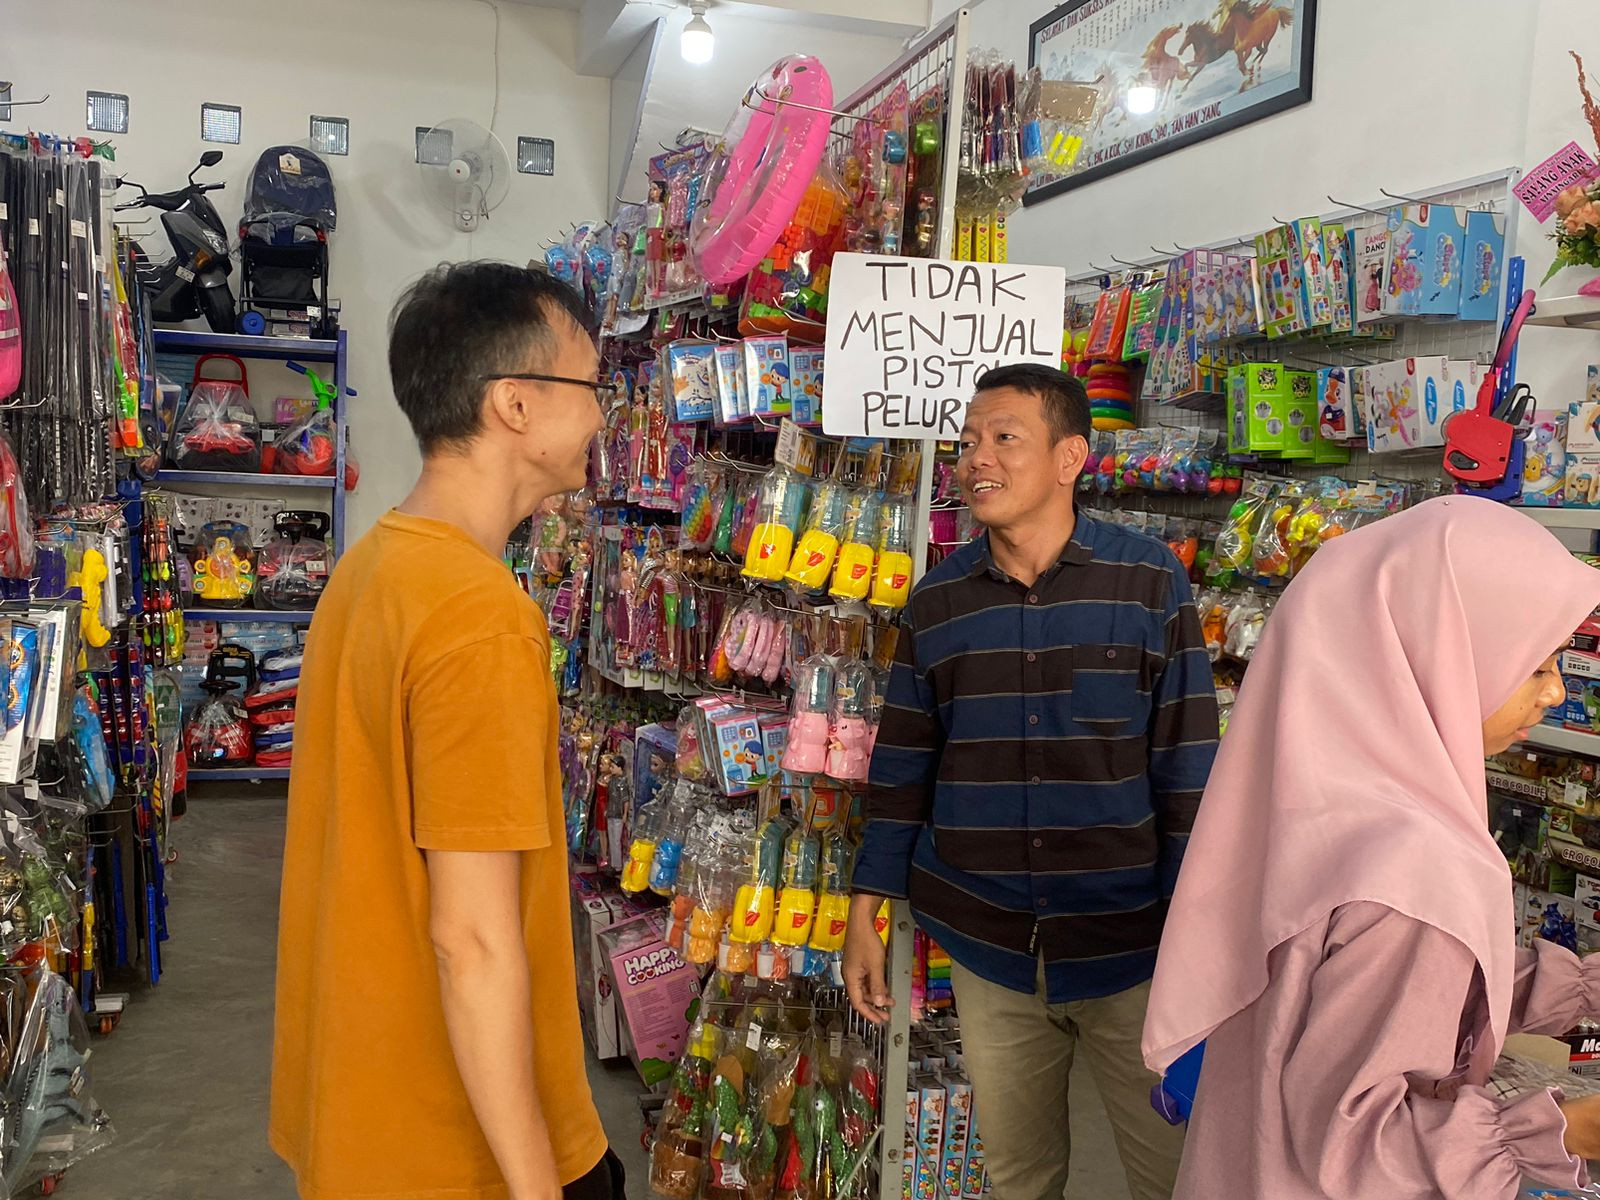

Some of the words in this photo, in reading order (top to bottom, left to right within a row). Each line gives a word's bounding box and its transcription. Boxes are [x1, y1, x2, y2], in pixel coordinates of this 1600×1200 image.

[1041, 18, 1066, 44] SELAMAT
[1067, 11, 1079, 29] DAN
[1171, 116, 1185, 135] TAN
[1185, 109, 1199, 128] HAN
[1201, 101, 1222, 123] YANG
[1522, 170, 1559, 204] SAYANG
[1556, 150, 1586, 175] ANAK
[1365, 241, 1386, 254] DANC
[865, 262, 1027, 307] TIDAK
[840, 311, 1054, 357] MENJUAL
[883, 355, 1001, 391] PISTO
[863, 391, 973, 435] PELUR
[1489, 775, 1547, 800] CROCODILE
[1562, 848, 1600, 869] CROCO
[628, 959, 687, 985] COOKING
